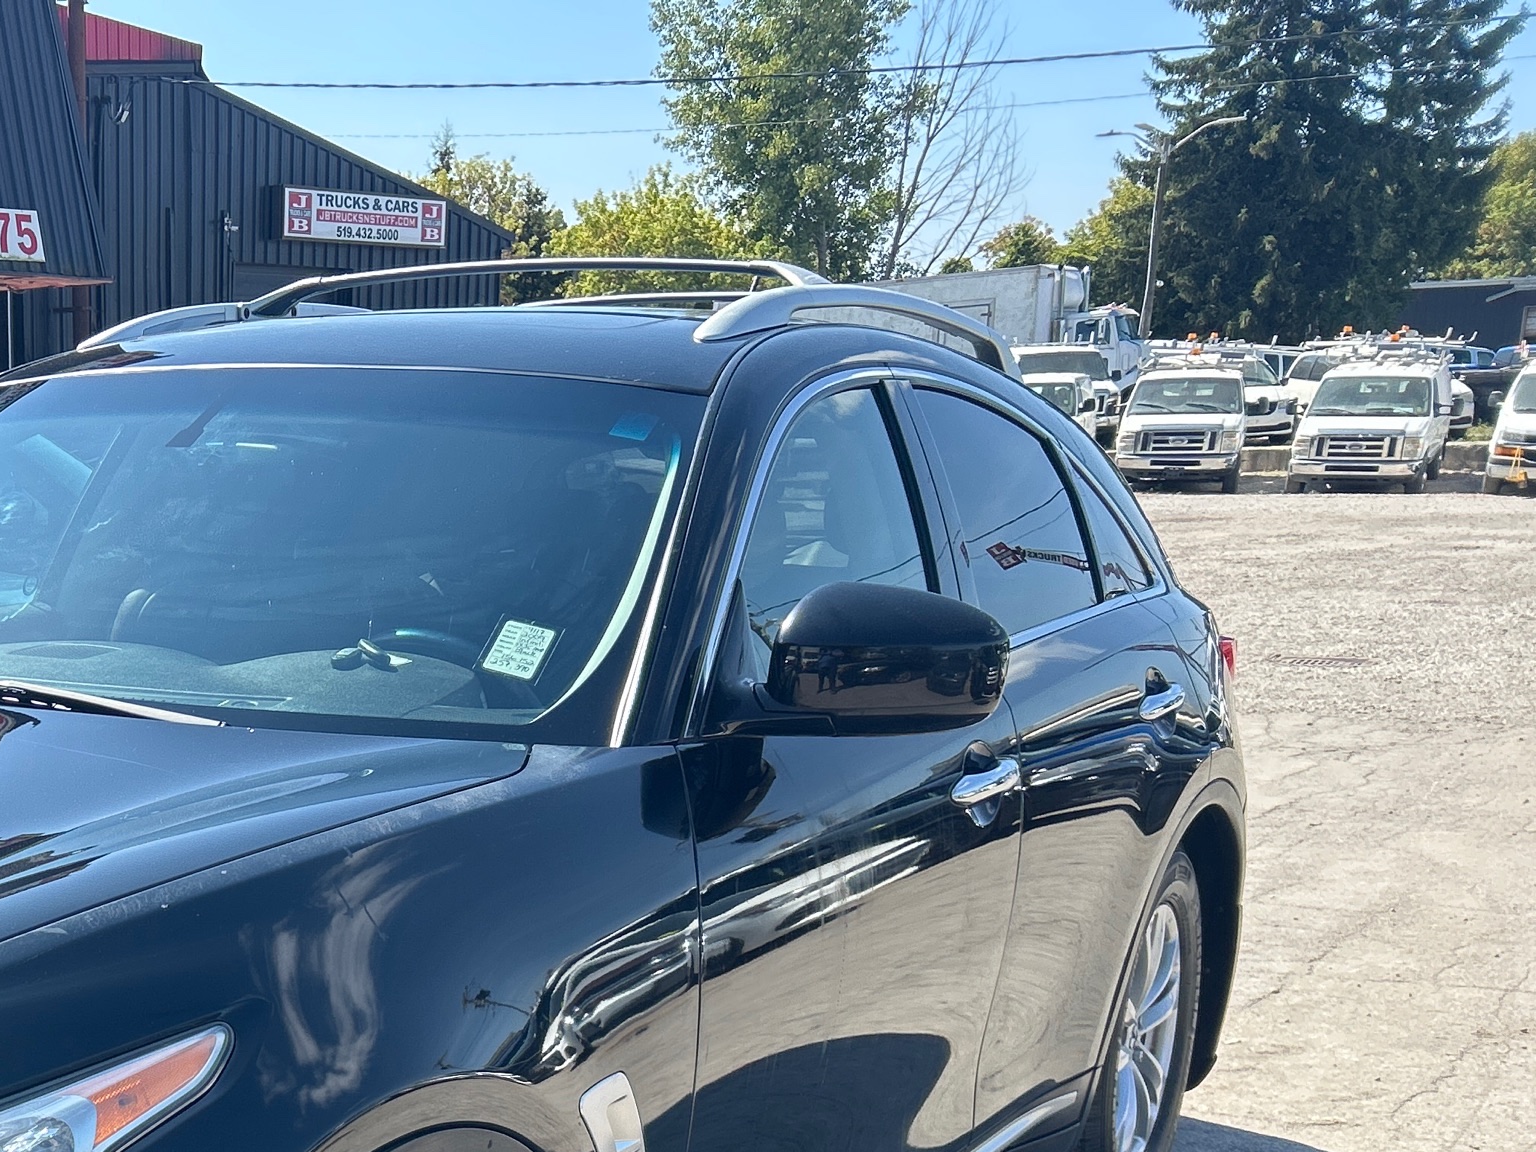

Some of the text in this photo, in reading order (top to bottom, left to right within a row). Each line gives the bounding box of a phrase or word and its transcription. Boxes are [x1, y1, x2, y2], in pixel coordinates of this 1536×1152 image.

[292, 194, 309, 208] J
[317, 193, 419, 214] TRUCKS & CARS
[318, 210, 417, 228] JBTRUCKSNSTUFF.COM
[425, 205, 439, 219] J
[291, 217, 309, 231] B
[336, 225, 399, 241] 519.432.5000
[424, 227, 440, 240] B
